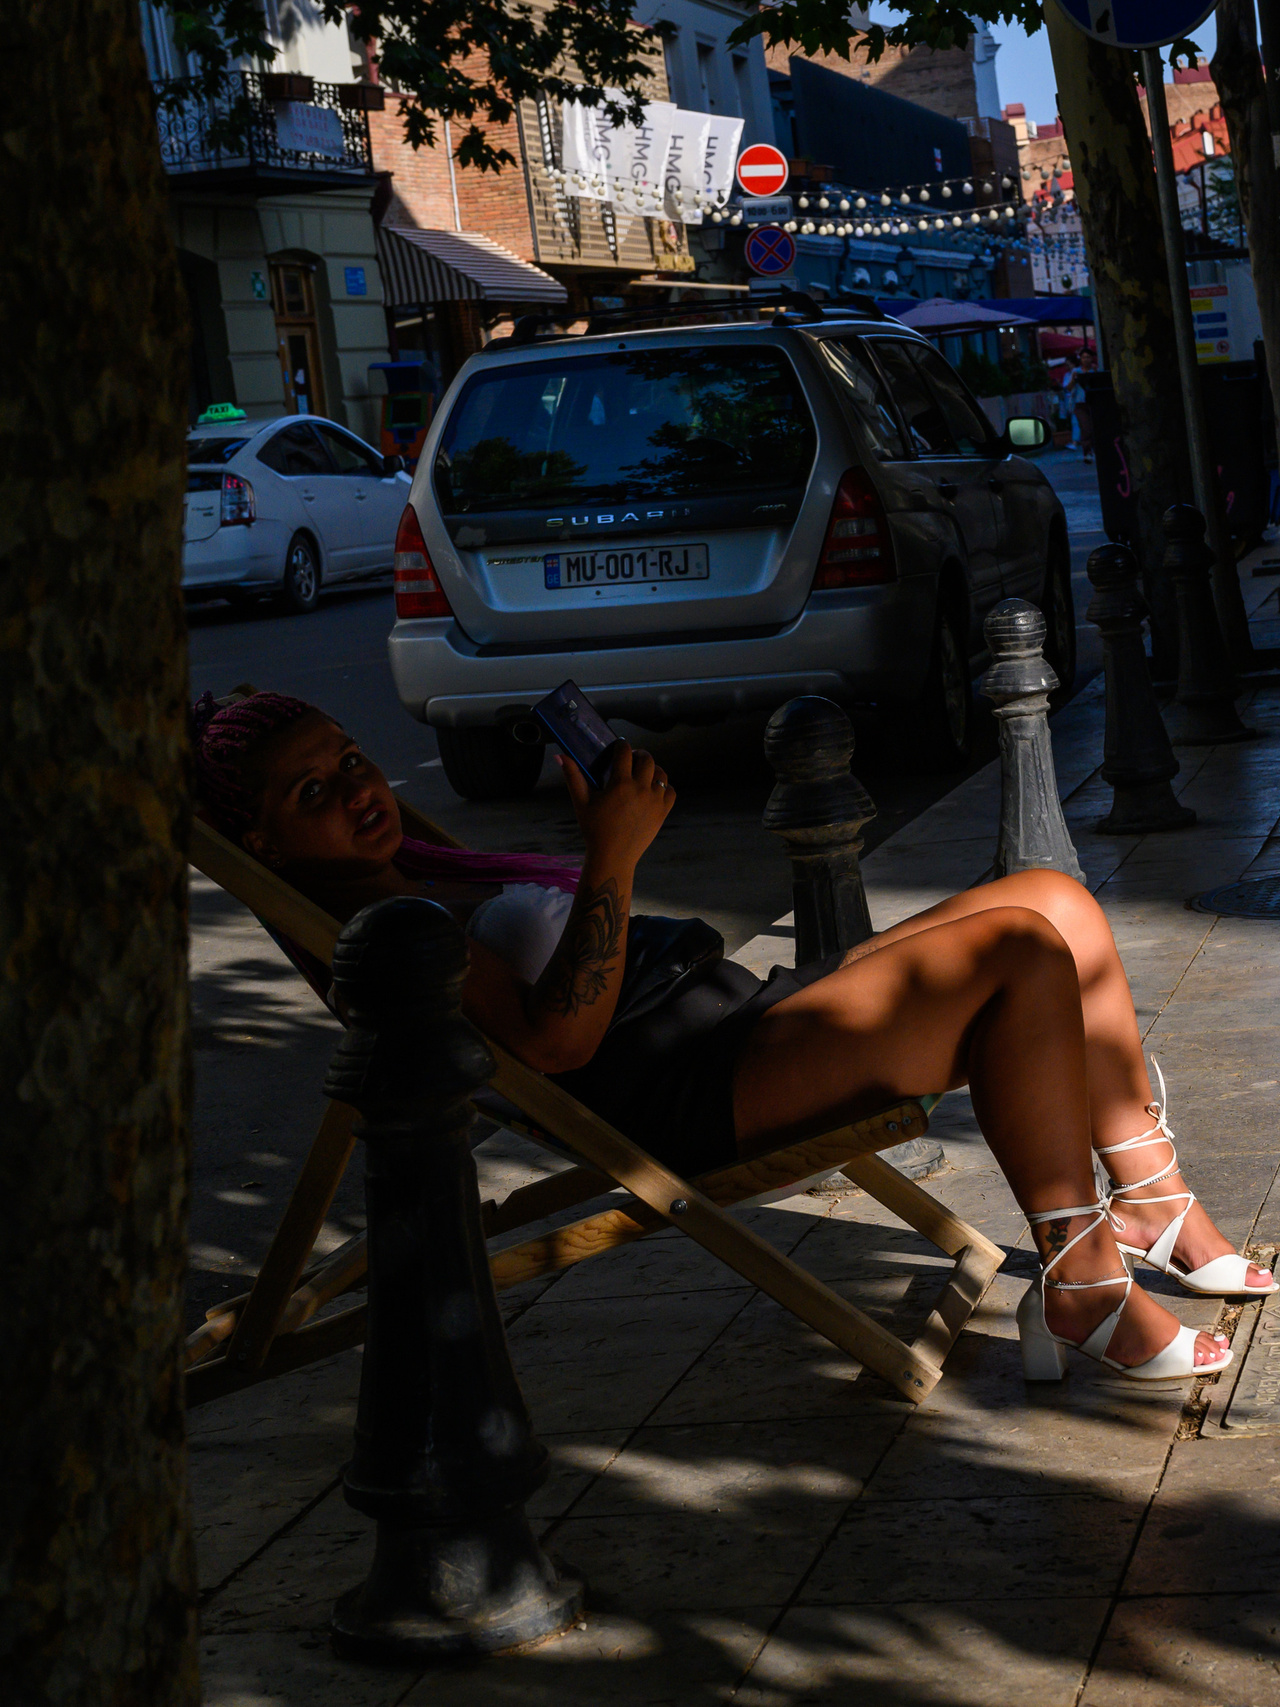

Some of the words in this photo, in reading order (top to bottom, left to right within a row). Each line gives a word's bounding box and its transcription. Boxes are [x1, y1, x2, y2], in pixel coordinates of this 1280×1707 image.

[631, 126, 653, 179] HMG
[665, 135, 684, 194] HMG
[210, 406, 229, 414] TAXI
[566, 549, 689, 582] MU-001-RJ
